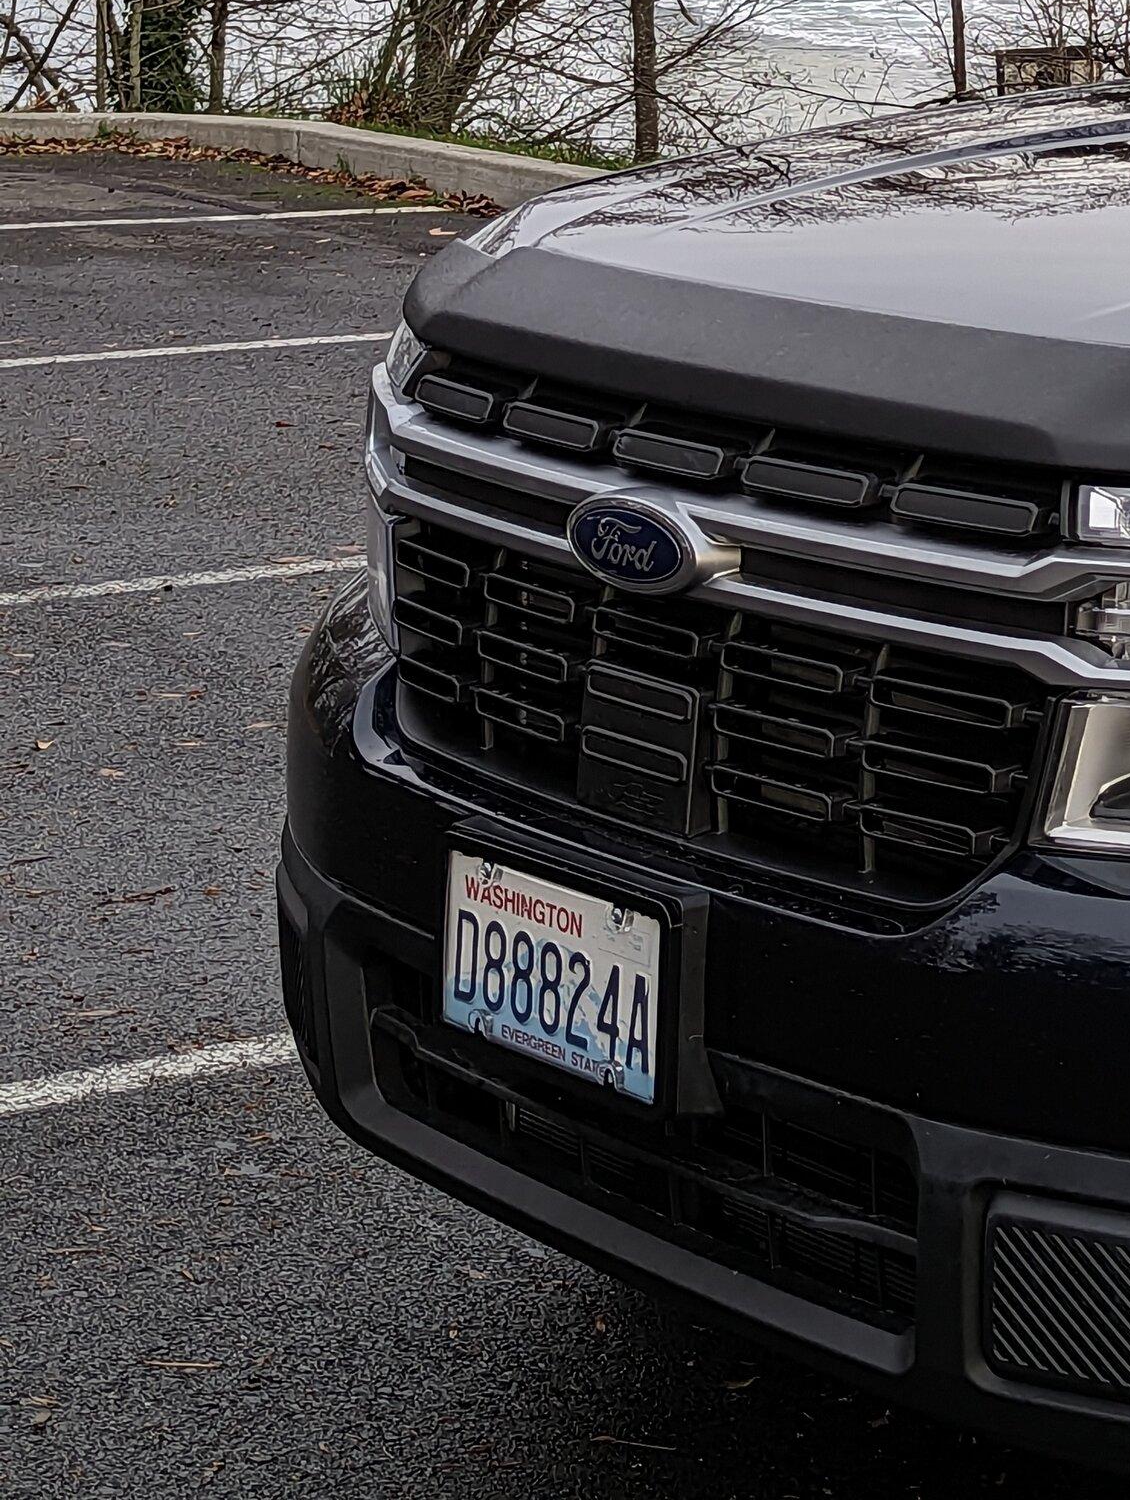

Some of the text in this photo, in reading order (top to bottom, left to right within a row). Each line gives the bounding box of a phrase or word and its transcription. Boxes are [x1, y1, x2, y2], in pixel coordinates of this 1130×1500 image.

[591, 517, 657, 572] Ford
[465, 874, 583, 938] WASHINGTON
[453, 908, 649, 1074] D88824A
[501, 1024, 566, 1062] EVERGREEN
